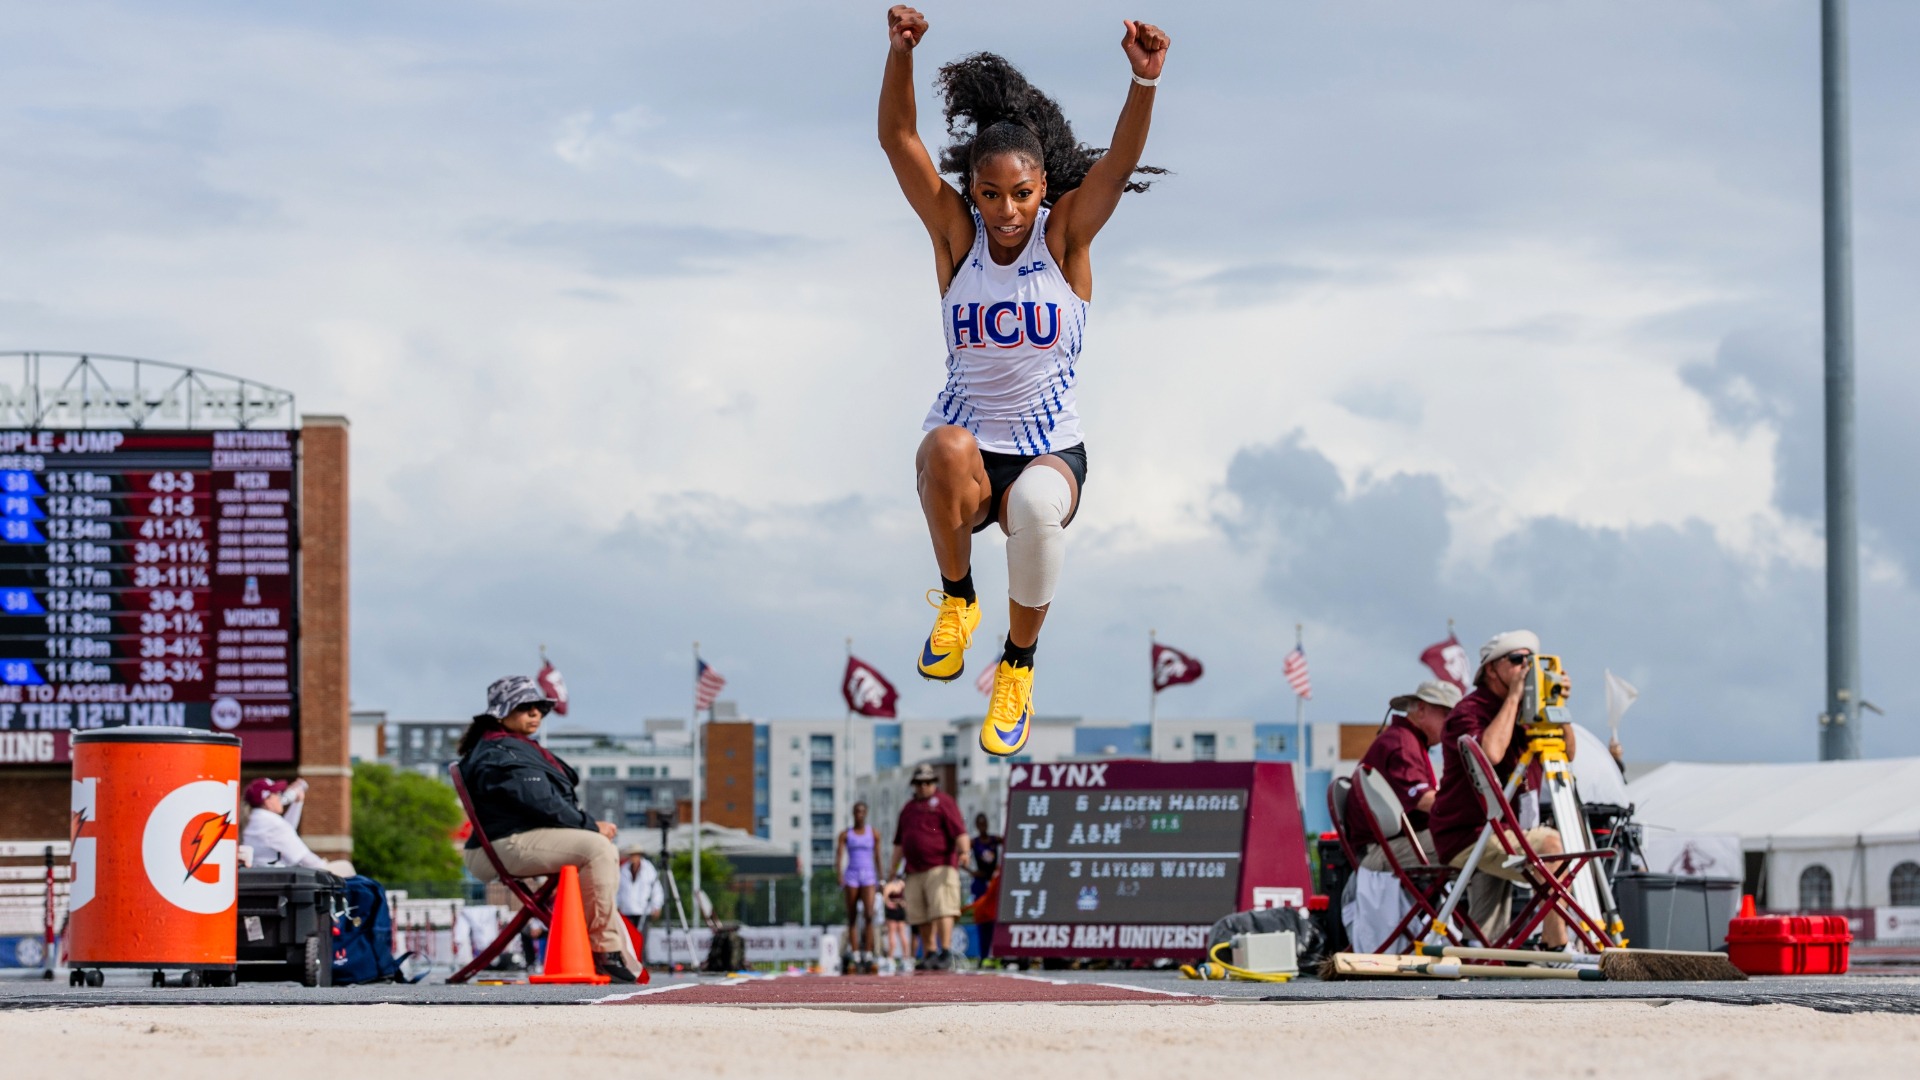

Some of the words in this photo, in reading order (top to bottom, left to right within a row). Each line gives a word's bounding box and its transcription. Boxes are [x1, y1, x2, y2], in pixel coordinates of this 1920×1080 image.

[952, 301, 1061, 349] HCU
[58, 431, 124, 453] JUMP
[213, 431, 291, 449] NATIONAL
[212, 450, 292, 467] CHAMPIONS
[7, 473, 28, 491] SB
[46, 472, 111, 492] 13.18m
[148, 471, 194, 492] 43-3
[233, 472, 270, 489] MEN
[7, 497, 28, 515] PB
[46, 495, 111, 516] 12.62m
[148, 495, 194, 516] 41-5
[46, 519, 111, 540] 12.54m
[46, 542, 111, 563] 12.18m
[46, 566, 111, 587] 12.17m
[46, 590, 111, 611] 12.04m
[149, 590, 194, 611] 39-6
[223, 608, 279, 627] WOMEN
[26, 685, 54, 702] TO
[56, 684, 173, 702] AGGIELAND
[20, 703, 72, 730] THE
[128, 703, 186, 727] MAN
[1030, 763, 1109, 788] LYNX
[1027, 795, 1050, 817] M
[1099, 796, 1162, 811] JADEN
[1168, 794, 1239, 811] HARRIS
[1017, 823, 1054, 849] TJ
[1068, 823, 1122, 844] A&M
[142, 780, 238, 914] G
[1019, 861, 1045, 883] W
[1069, 861, 1082, 877] 3
[1161, 862, 1226, 877] WATSON
[1010, 889, 1047, 919] TJ
[1009, 925, 1070, 948] TEXAS
[1072, 925, 1115, 948] A&M
